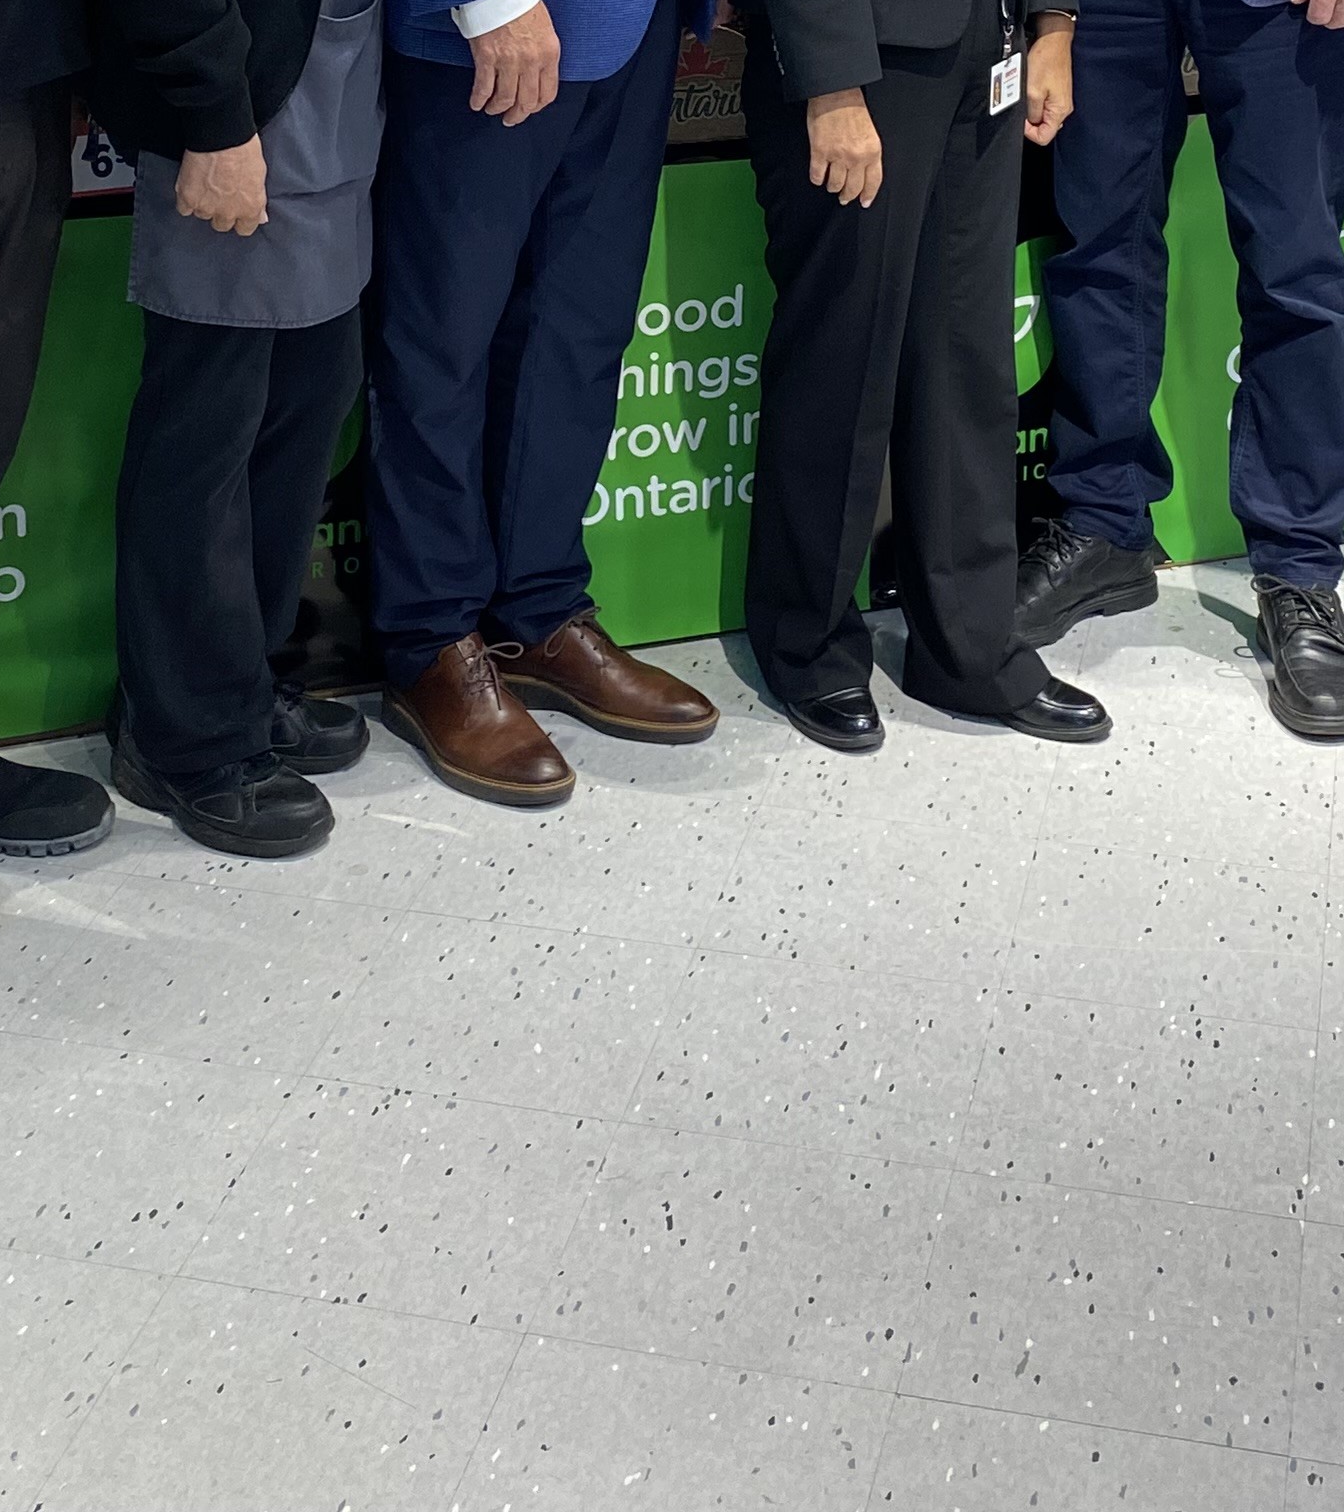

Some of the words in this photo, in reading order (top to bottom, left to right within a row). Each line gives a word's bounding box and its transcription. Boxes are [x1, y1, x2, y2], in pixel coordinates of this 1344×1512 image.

[637, 284, 744, 337] ood
[617, 352, 759, 399] hings
[609, 415, 707, 461] row
